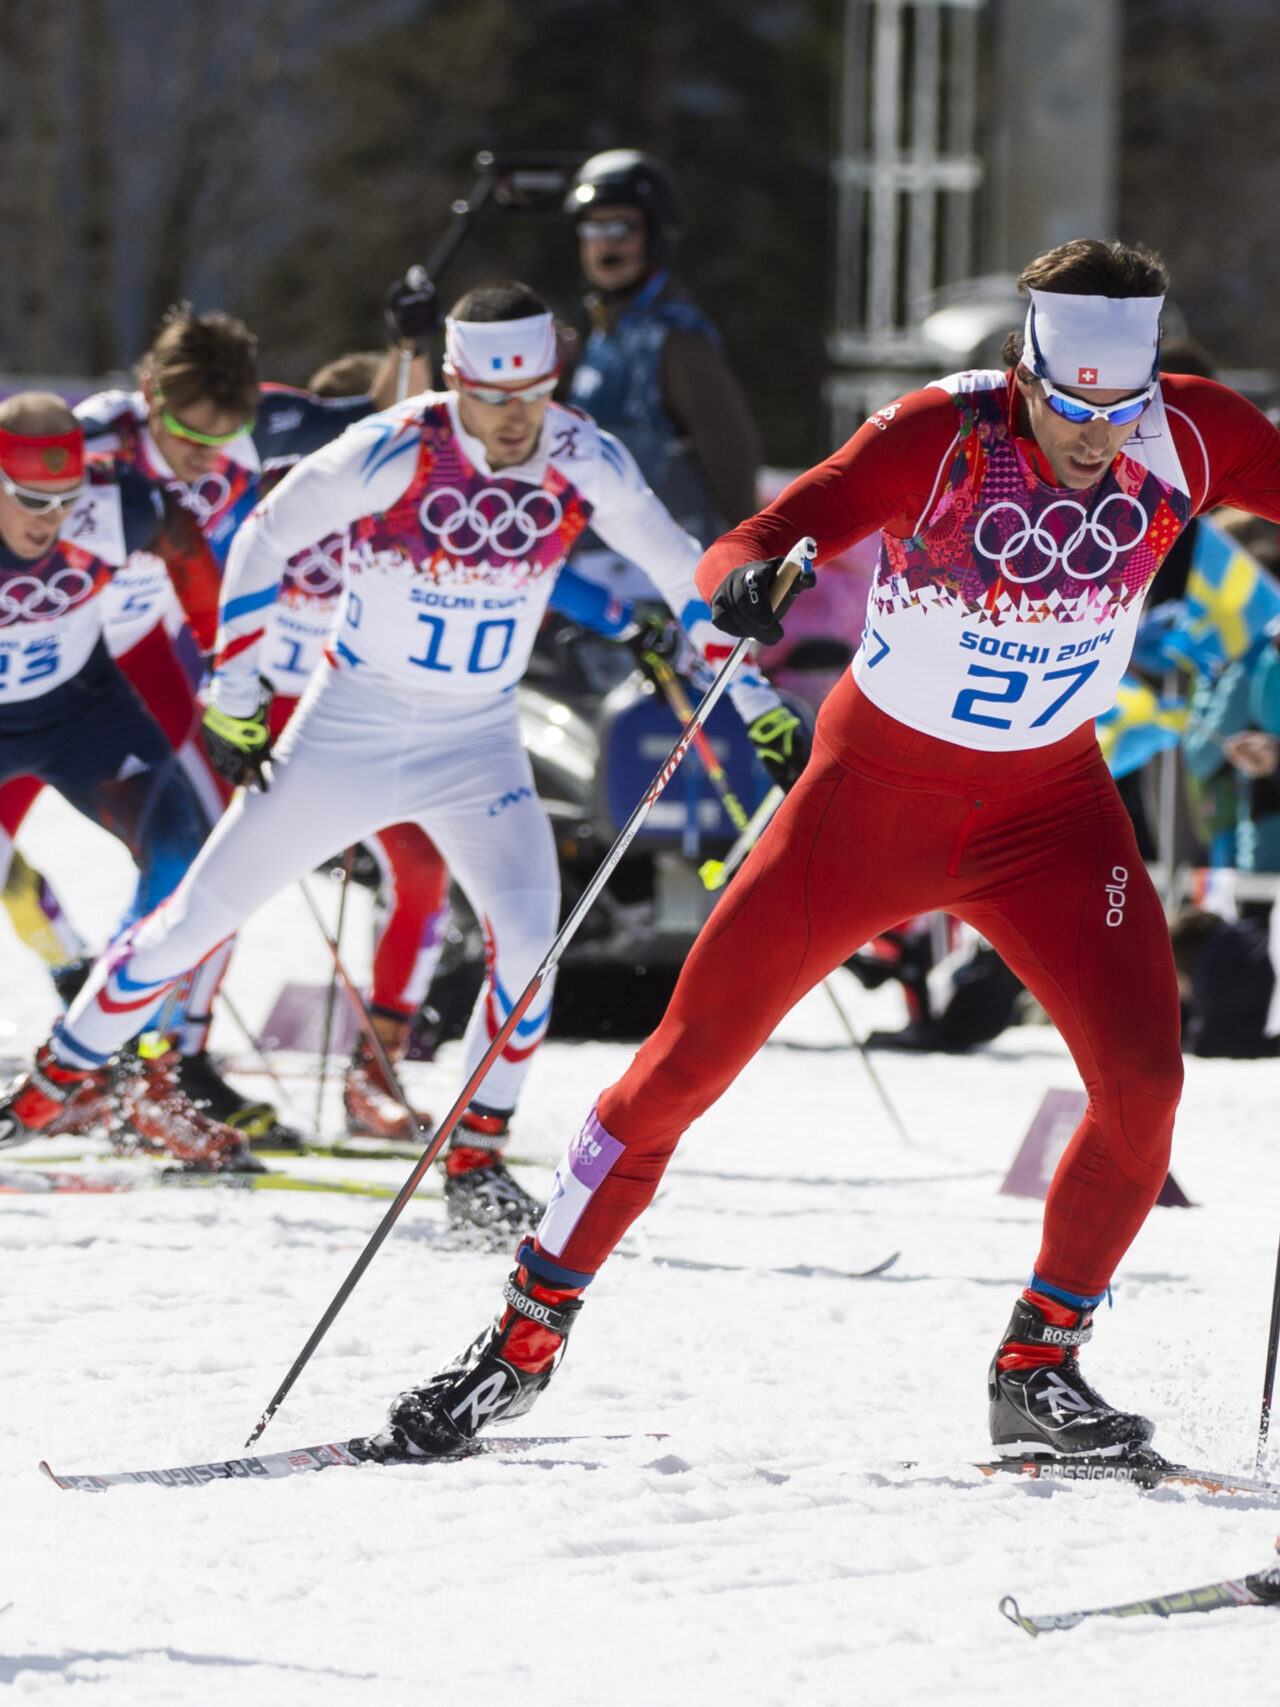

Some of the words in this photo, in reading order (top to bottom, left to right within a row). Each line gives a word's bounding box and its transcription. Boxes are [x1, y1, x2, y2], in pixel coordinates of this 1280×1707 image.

[408, 613, 516, 673] 10
[959, 631, 1049, 664] SOCHI
[1056, 629, 1114, 662] 2014
[951, 659, 1100, 730] 27
[1105, 866, 1128, 927] odlo
